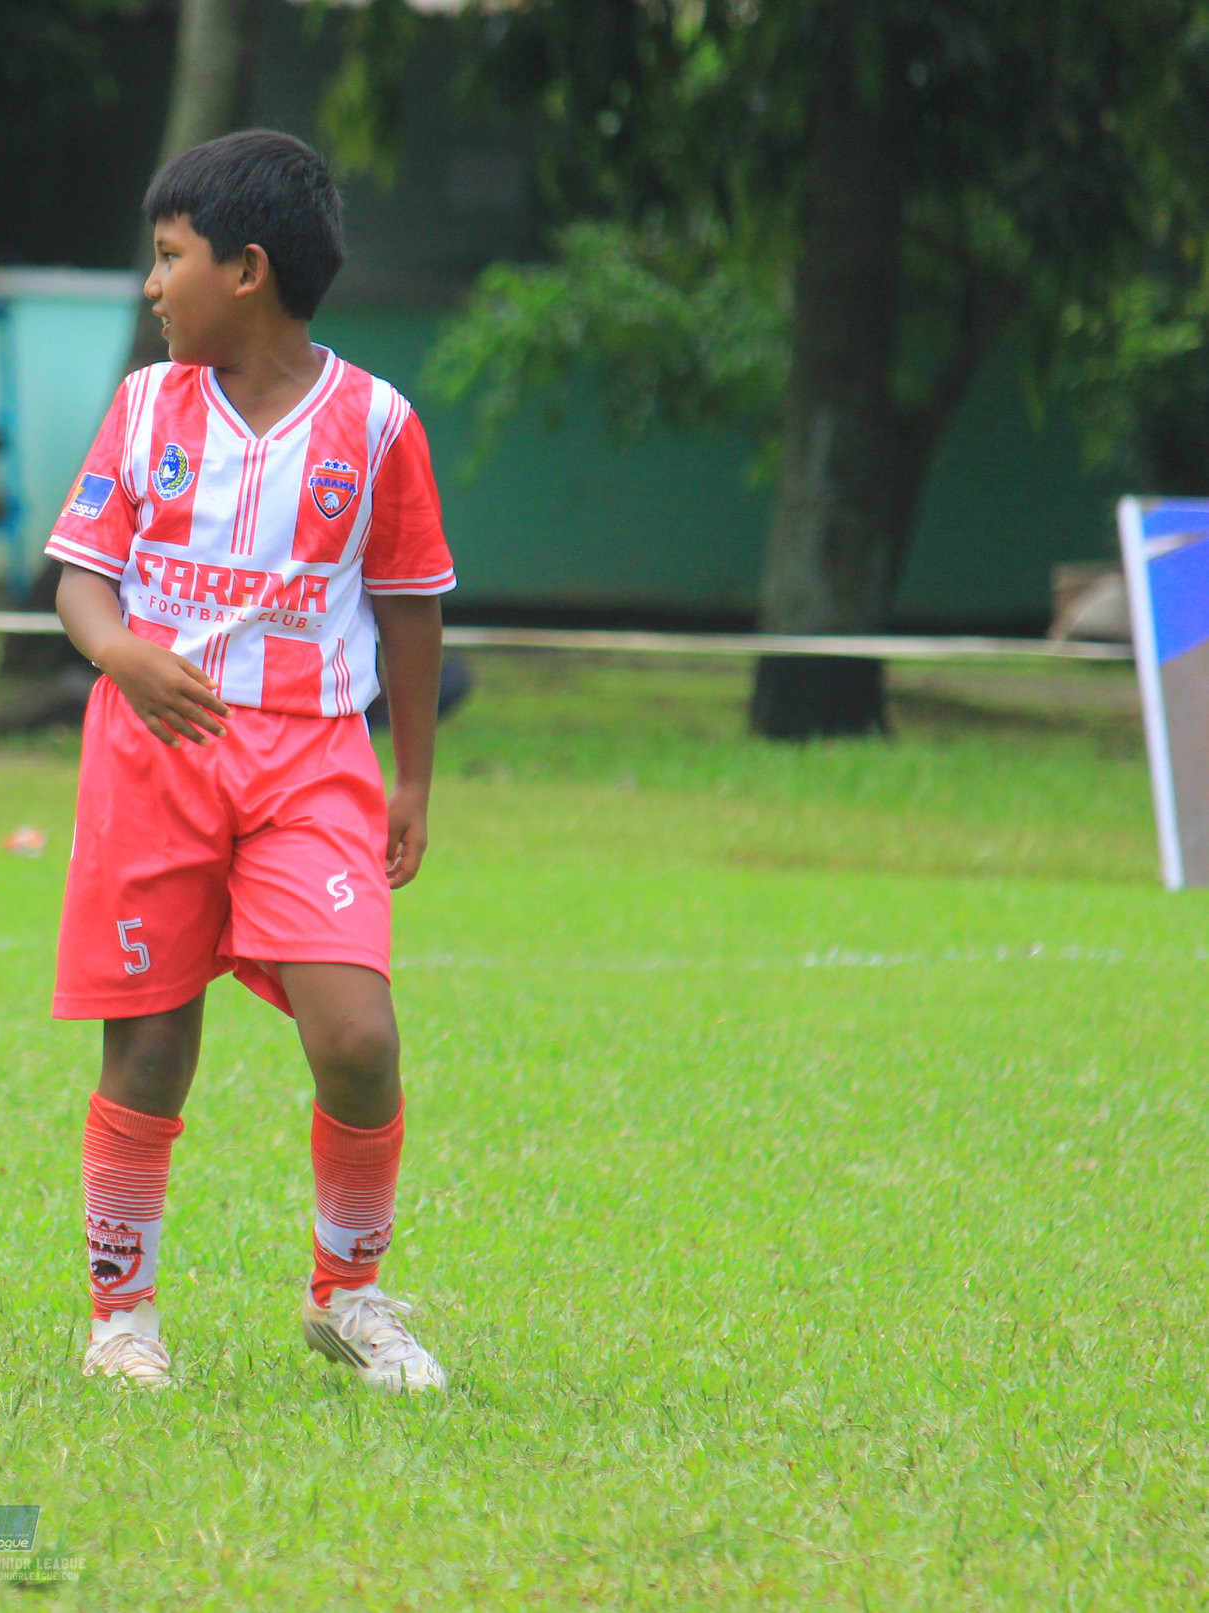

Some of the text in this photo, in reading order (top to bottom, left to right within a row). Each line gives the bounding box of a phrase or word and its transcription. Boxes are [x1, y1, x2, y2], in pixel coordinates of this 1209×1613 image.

[309, 477, 357, 494] FARAMA
[134, 550, 330, 614] FARAMA
[149, 595, 247, 623] FOOTBALL
[116, 917, 152, 975] 5
